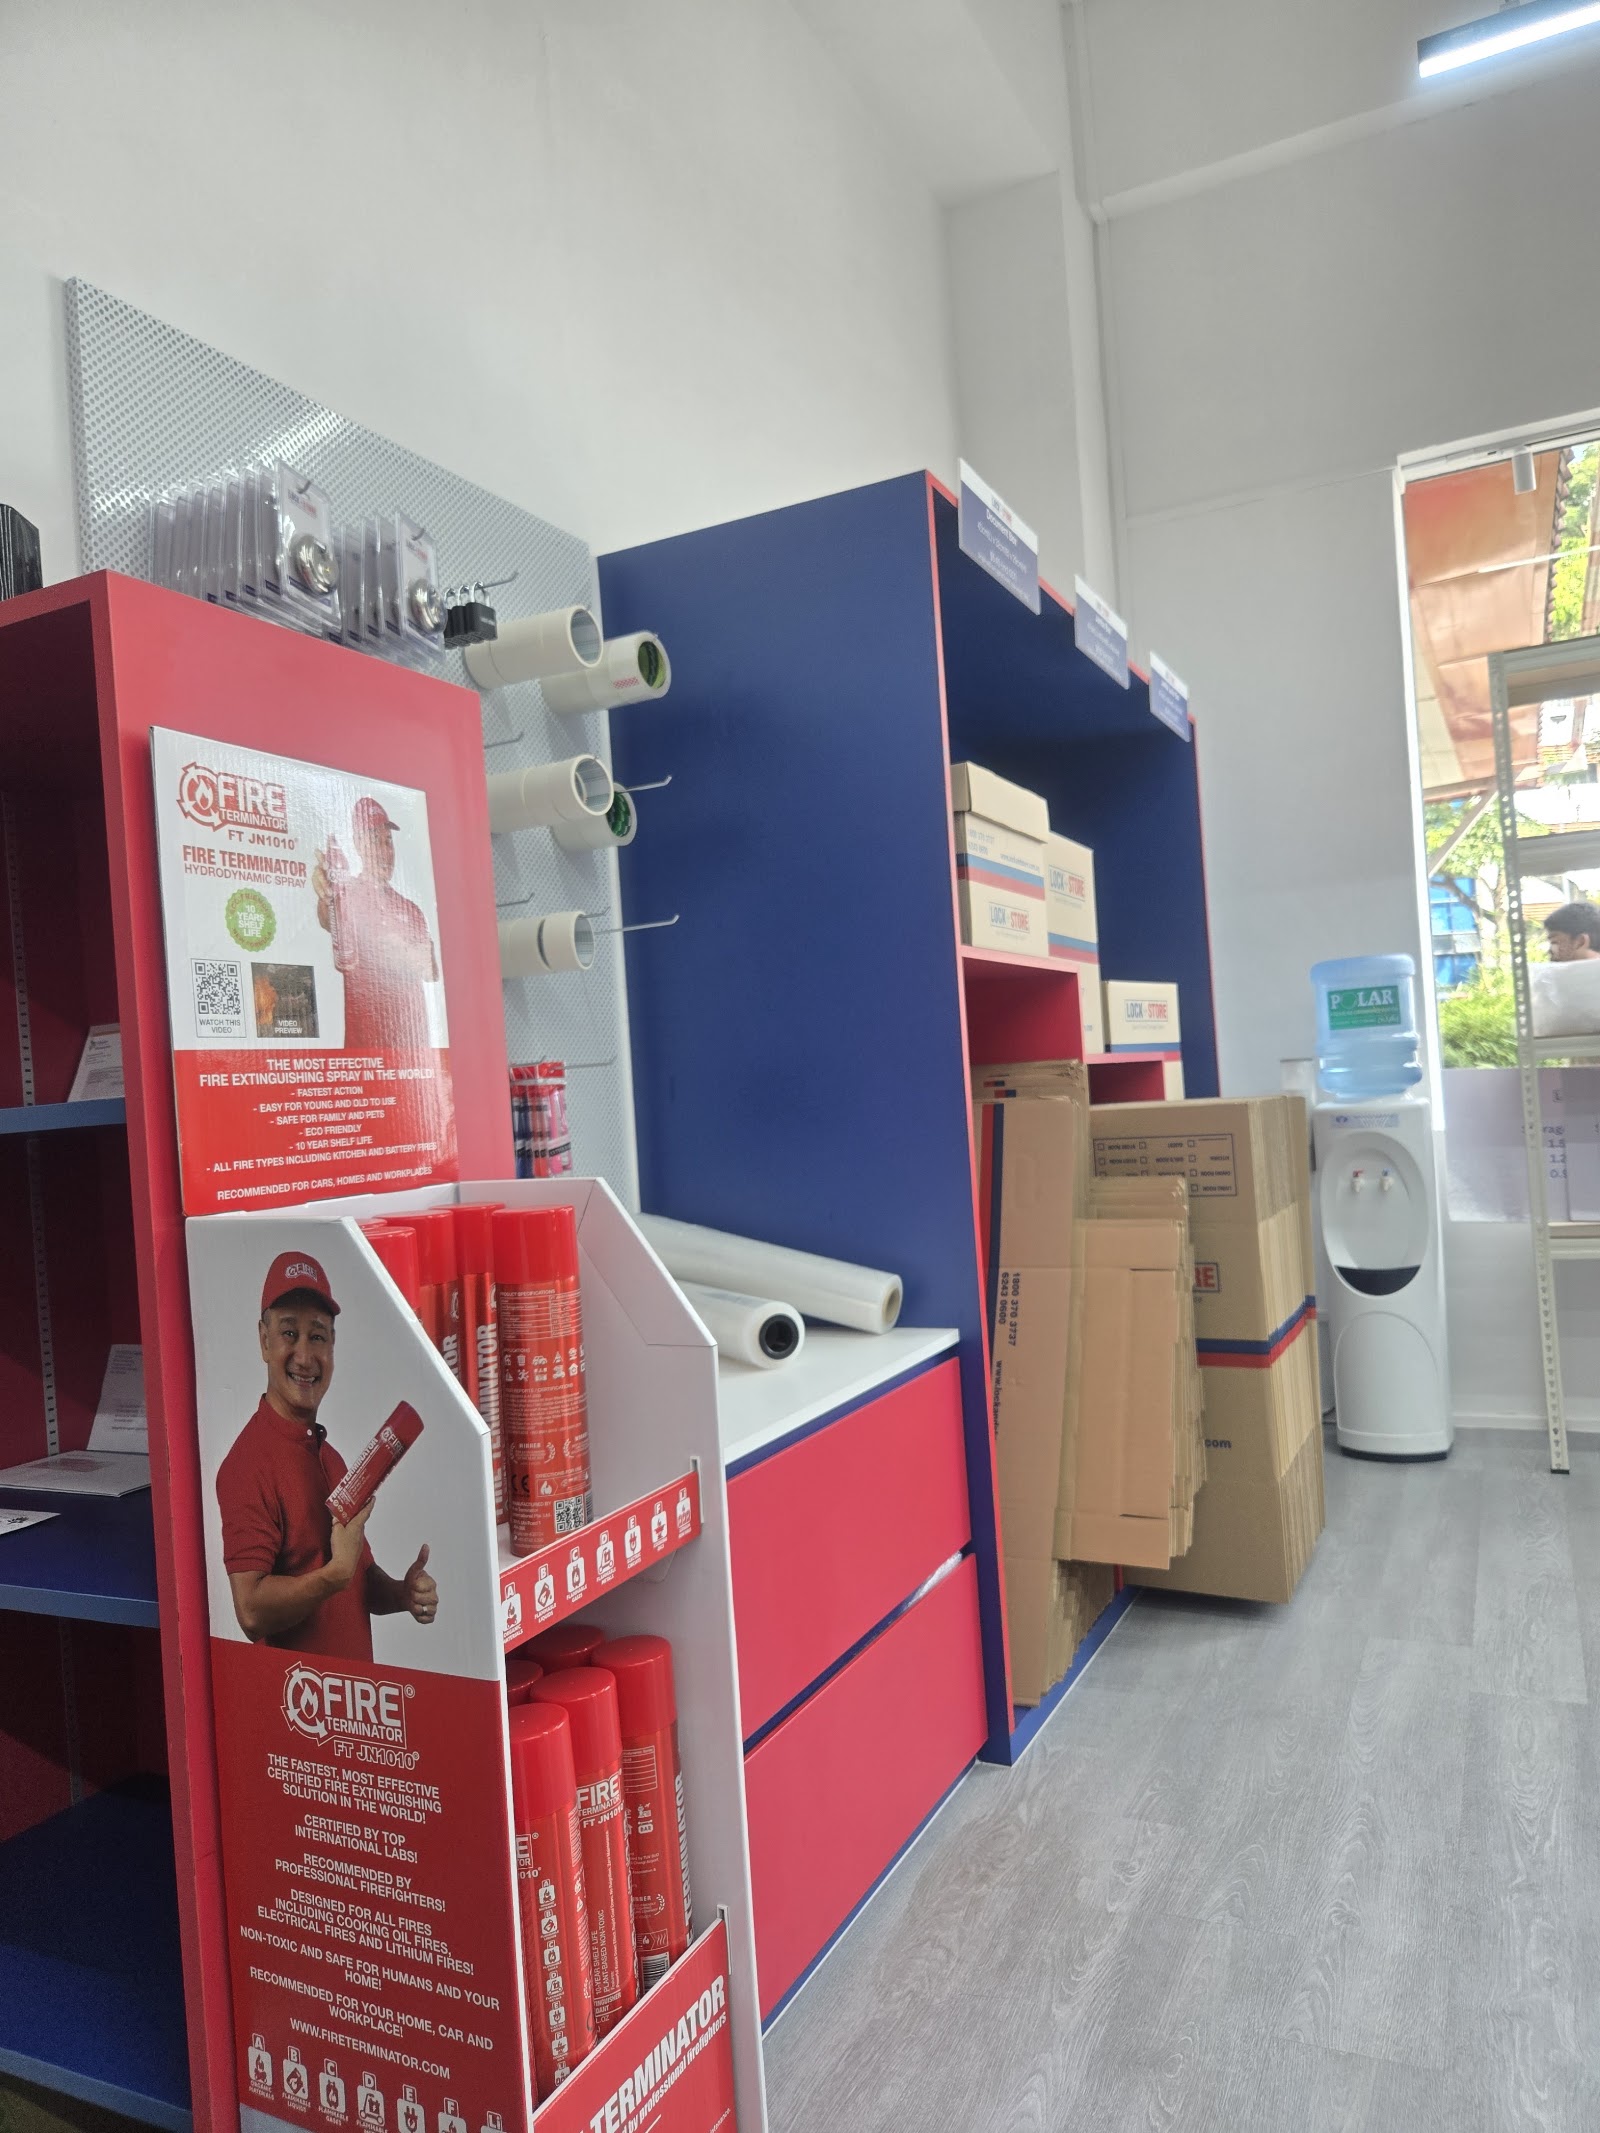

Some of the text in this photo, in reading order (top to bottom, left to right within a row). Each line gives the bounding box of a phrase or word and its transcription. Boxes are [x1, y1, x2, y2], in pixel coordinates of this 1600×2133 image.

[218, 775, 286, 818] FIRE
[220, 810, 287, 830] TERMINATOR
[228, 830, 244, 842] FT
[183, 845, 307, 877] FIRE TERMINATOR
[184, 864, 306, 888] HYDRODYNAMIC SPRAY
[1049, 869, 1085, 898] LOCK STORE
[237, 912, 264, 921] YEARS
[245, 905, 255, 913] 10
[990, 905, 1029, 931] LOCK STORE
[239, 920, 264, 930] SHELF
[244, 929, 261, 937] LIFE
[1126, 1003, 1167, 1019] LOCK STORE
[266, 1057, 384, 1070] THE MOST EFFECTIVE
[200, 1074, 229, 1086] FIRE
[232, 1071, 324, 1085] EXTINGUISHING
[327, 1071, 361, 1083] SPRAY
[364, 1071, 374, 1080] IN
[376, 1070, 396, 1080] THE
[260, 1096, 396, 1112] EASY FOR YOUNG AND OLD TO USE
[297, 1086, 363, 1097] FASTEST ACTION
[277, 1110, 385, 1125] SAFE FOR FAMILY AND PETS
[306, 1124, 362, 1136] ECO FRIENDLY
[296, 1136, 373, 1150] 10 YEAR SHELF LIFE
[213, 1141, 437, 1172] ALL FIRE TYPES INCLUDING KITCHEN AND BATTERY FIRES
[217, 1166, 433, 1200] RECOMMENDED FOR CARS, HOMES AND WORKPLACES
[998, 1272, 1009, 1325] 6243 0600
[1011, 1298, 1019, 1318] 370
[1008, 1320, 1017, 1347] 3737
[323, 1677, 401, 1727] FIRE
[325, 1716, 403, 1743] TERMINATOR
[334, 1740, 354, 1758] FT
[268, 1753, 439, 1799] THE FASTEST, MOST EFFECTIVE
[267, 1767, 442, 1813] CERTIFIED FIRE EXTINGUISHING
[577, 1775, 619, 1809] FIRE
[283, 1783, 426, 1824] SOLUTION IN THE WORLD!
[578, 1794, 620, 1816] TERMINATOR
[304, 1814, 405, 1847] CERTIFIED BY TOP
[583, 1819, 595, 1828] FT
[295, 1824, 418, 1864] INTERNATIONAL LABS!
[303, 1853, 411, 1889] RECOMMENDED BY
[275, 1859, 446, 1912] PROFESSIONAL FIREFIGHTERS!
[290, 1889, 431, 1936] DESIGNED FOR ALL FIRES
[258, 1905, 474, 1975] ELECTRICAL FIRES AND LITHIUM FIRES!
[275, 1897, 451, 1957] INCLUDING COOKING OIL FIRES,
[597, 1909, 606, 1946] NON-TOXIC
[240, 1925, 500, 2010] NON-TOXIC AND SAFE FOR HUMANS AND YOUR
[592, 1945, 600, 1966] SHELF
[345, 1969, 382, 1991] HOME!
[593, 1966, 601, 1995] 10-YEAR
[600, 1946, 610, 1993] PLANT-BASED
[250, 1966, 493, 2051] RECOMMENDED FOR YOUR HOME, CAR AND
[329, 2004, 403, 2038] WORKPLACE!
[254, 2036, 263, 2049] A
[290, 2017, 450, 2079] WWW.FIRETERMINATOR.COM
[290, 2049, 298, 2062] B
[590, 1975, 725, 2133] TERMINATOR
[327, 2063, 335, 2076] C
[366, 2074, 375, 2088] D
[639, 2055, 687, 2124] professional
[687, 2012, 726, 2066] firefighters
[405, 2087, 414, 2101] E
[447, 2101, 455, 2114] F
[489, 2114, 500, 2129] Li
